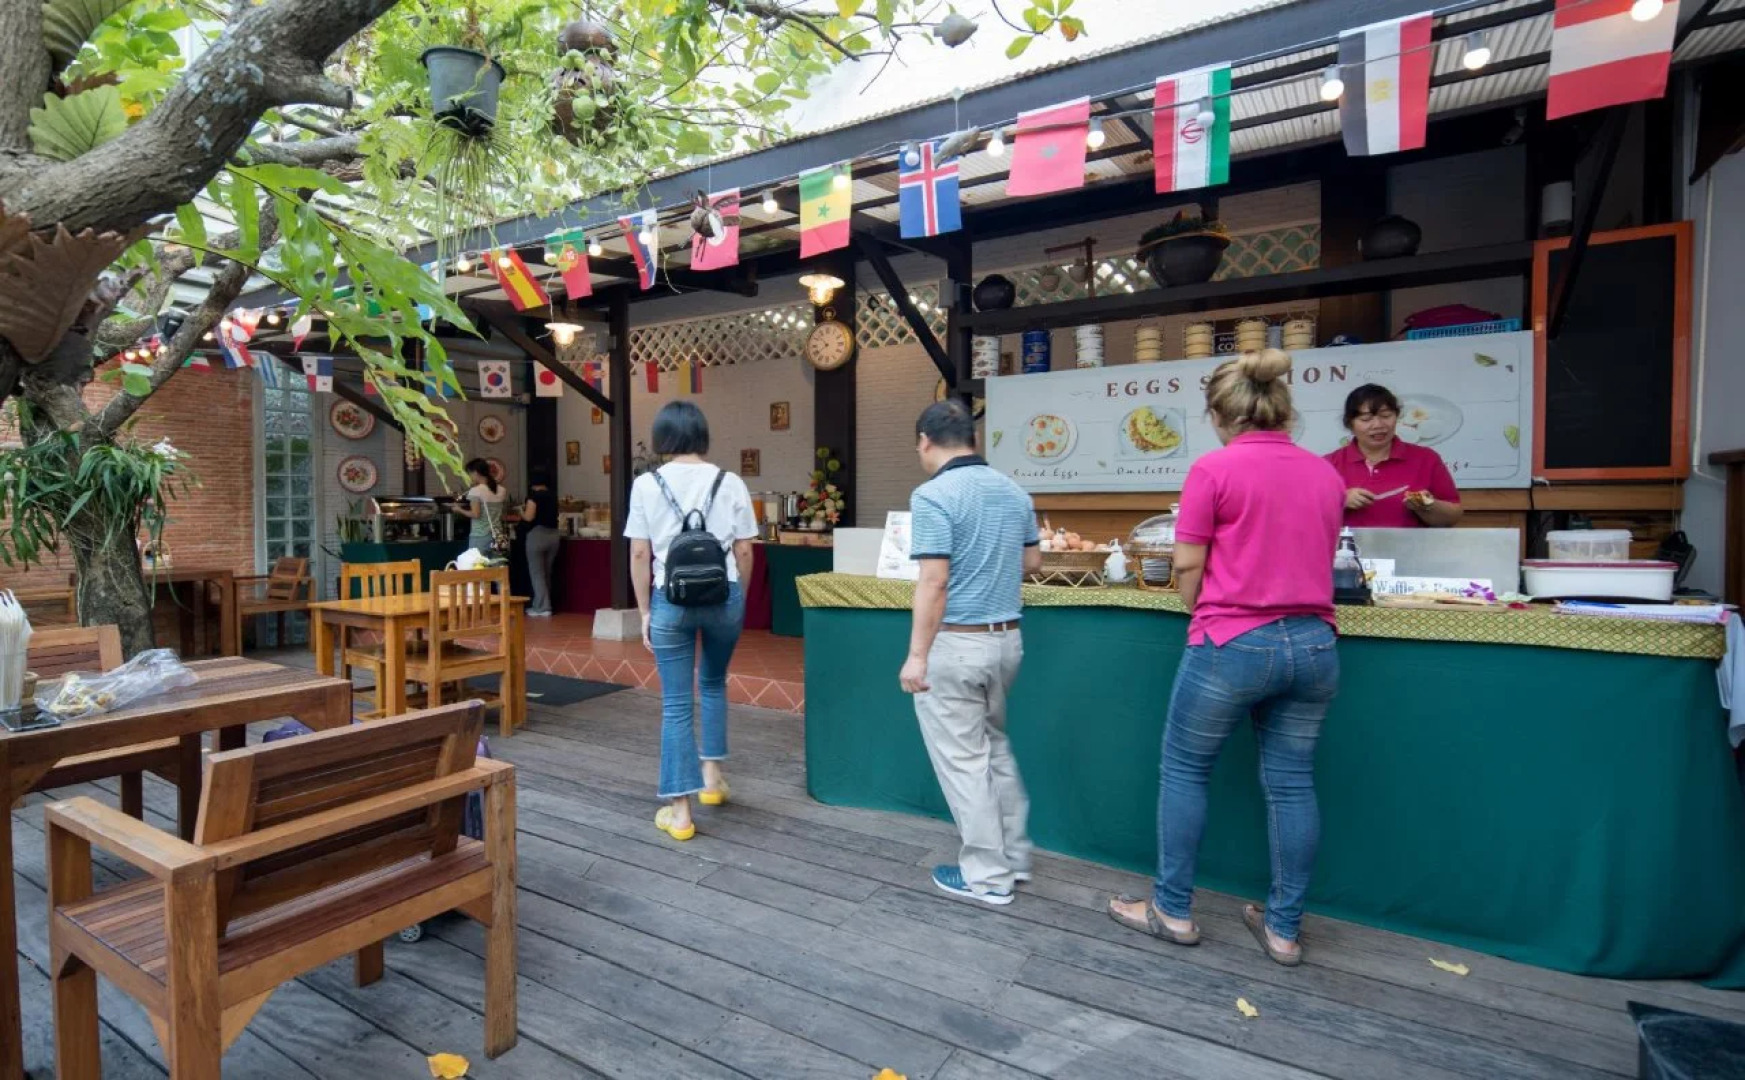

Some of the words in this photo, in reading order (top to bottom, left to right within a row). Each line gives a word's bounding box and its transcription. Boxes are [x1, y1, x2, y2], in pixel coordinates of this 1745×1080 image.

[1106, 378, 1181, 398] EGGS
[1200, 365, 1349, 391] SION
[1375, 580, 1415, 594] Waffle
